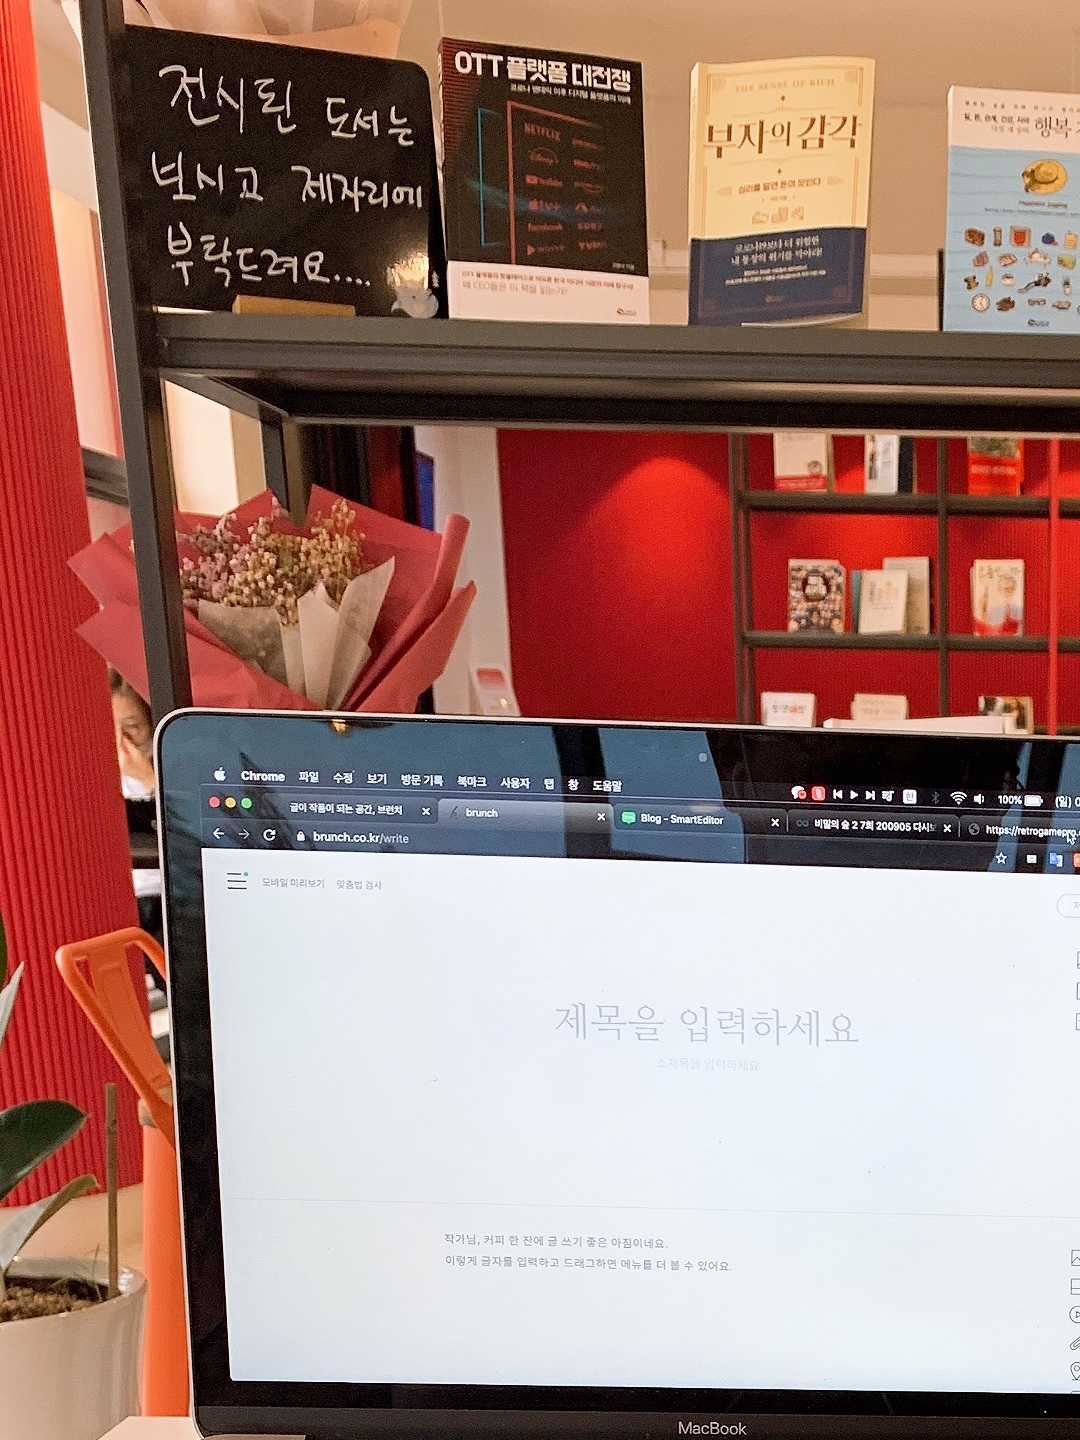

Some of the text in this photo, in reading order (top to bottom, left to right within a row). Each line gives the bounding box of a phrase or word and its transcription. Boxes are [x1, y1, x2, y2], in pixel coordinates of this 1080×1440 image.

[455, 51, 632, 93] OTT 플랫폼 대전쟁
[758, 81, 789, 91] SENSE
[809, 78, 836, 88] RICH
[158, 64, 415, 147] 전시된 도서는
[1035, 116, 1073, 139] 행복
[703, 114, 863, 159] 부자의 감각
[151, 151, 425, 213] 보시고 제자리에
[240, 770, 623, 793] Chrome 파일 수정 보기 방문 기록 북마크 사용자 탭 창 도움말
[998, 794, 1023, 806] 100%
[1055, 796, 1073, 809] (일)
[289, 802, 403, 817] 글이 작품이 되는 공간, 브런치
[465, 807, 499, 819] brunch
[640, 813, 725, 827] Blog SmartEditor
[814, 817, 840, 831] 비밀의
[841, 818, 851, 831] 숲
[851, 819, 859, 831] 2
[876, 821, 912, 833] 200905
[313, 831, 410, 845] brunch.co.kr/write
[262, 877, 326, 889] 모바일 미리보기
[336, 879, 383, 891] 맞춤법 검사
[554, 1001, 860, 1048] 제목을 입력하세요
[656, 1057, 760, 1072] 소제목을 입력하세요
[444, 1233, 669, 1250] 작가님, 커피 한 잔에 글 쓰기 좋은 아침이네요.
[445, 1254, 734, 1273] 이렇게 글자를 입력하고 드래그하면 메뉴를 더 볼 수 있어요.
[678, 1421, 747, 1436] MacBook
